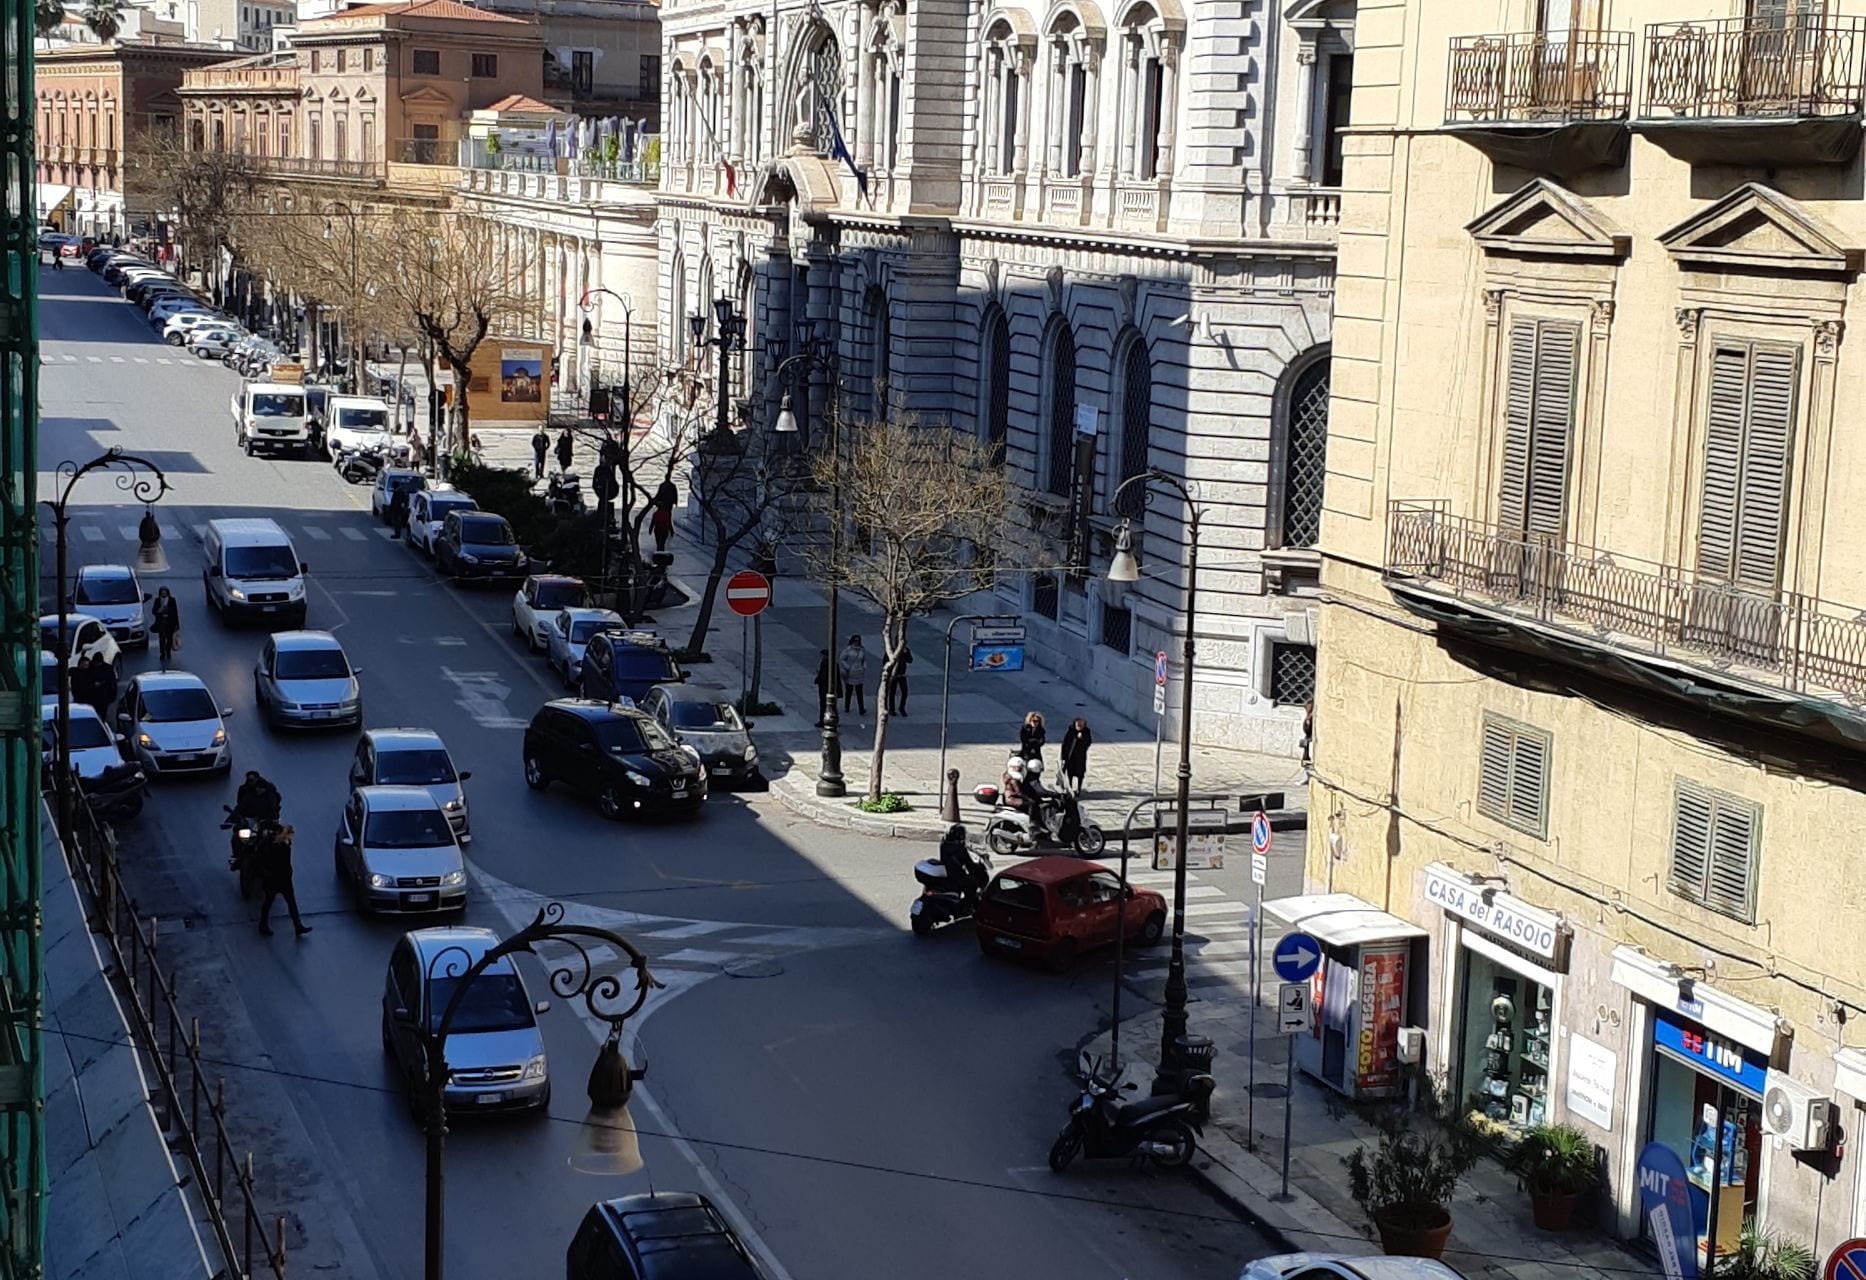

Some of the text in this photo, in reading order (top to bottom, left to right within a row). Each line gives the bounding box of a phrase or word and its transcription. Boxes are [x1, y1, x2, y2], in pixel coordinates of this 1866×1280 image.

[1429, 879, 1552, 950] CASA del RASOIO
[1705, 1031, 1744, 1075] TIM
